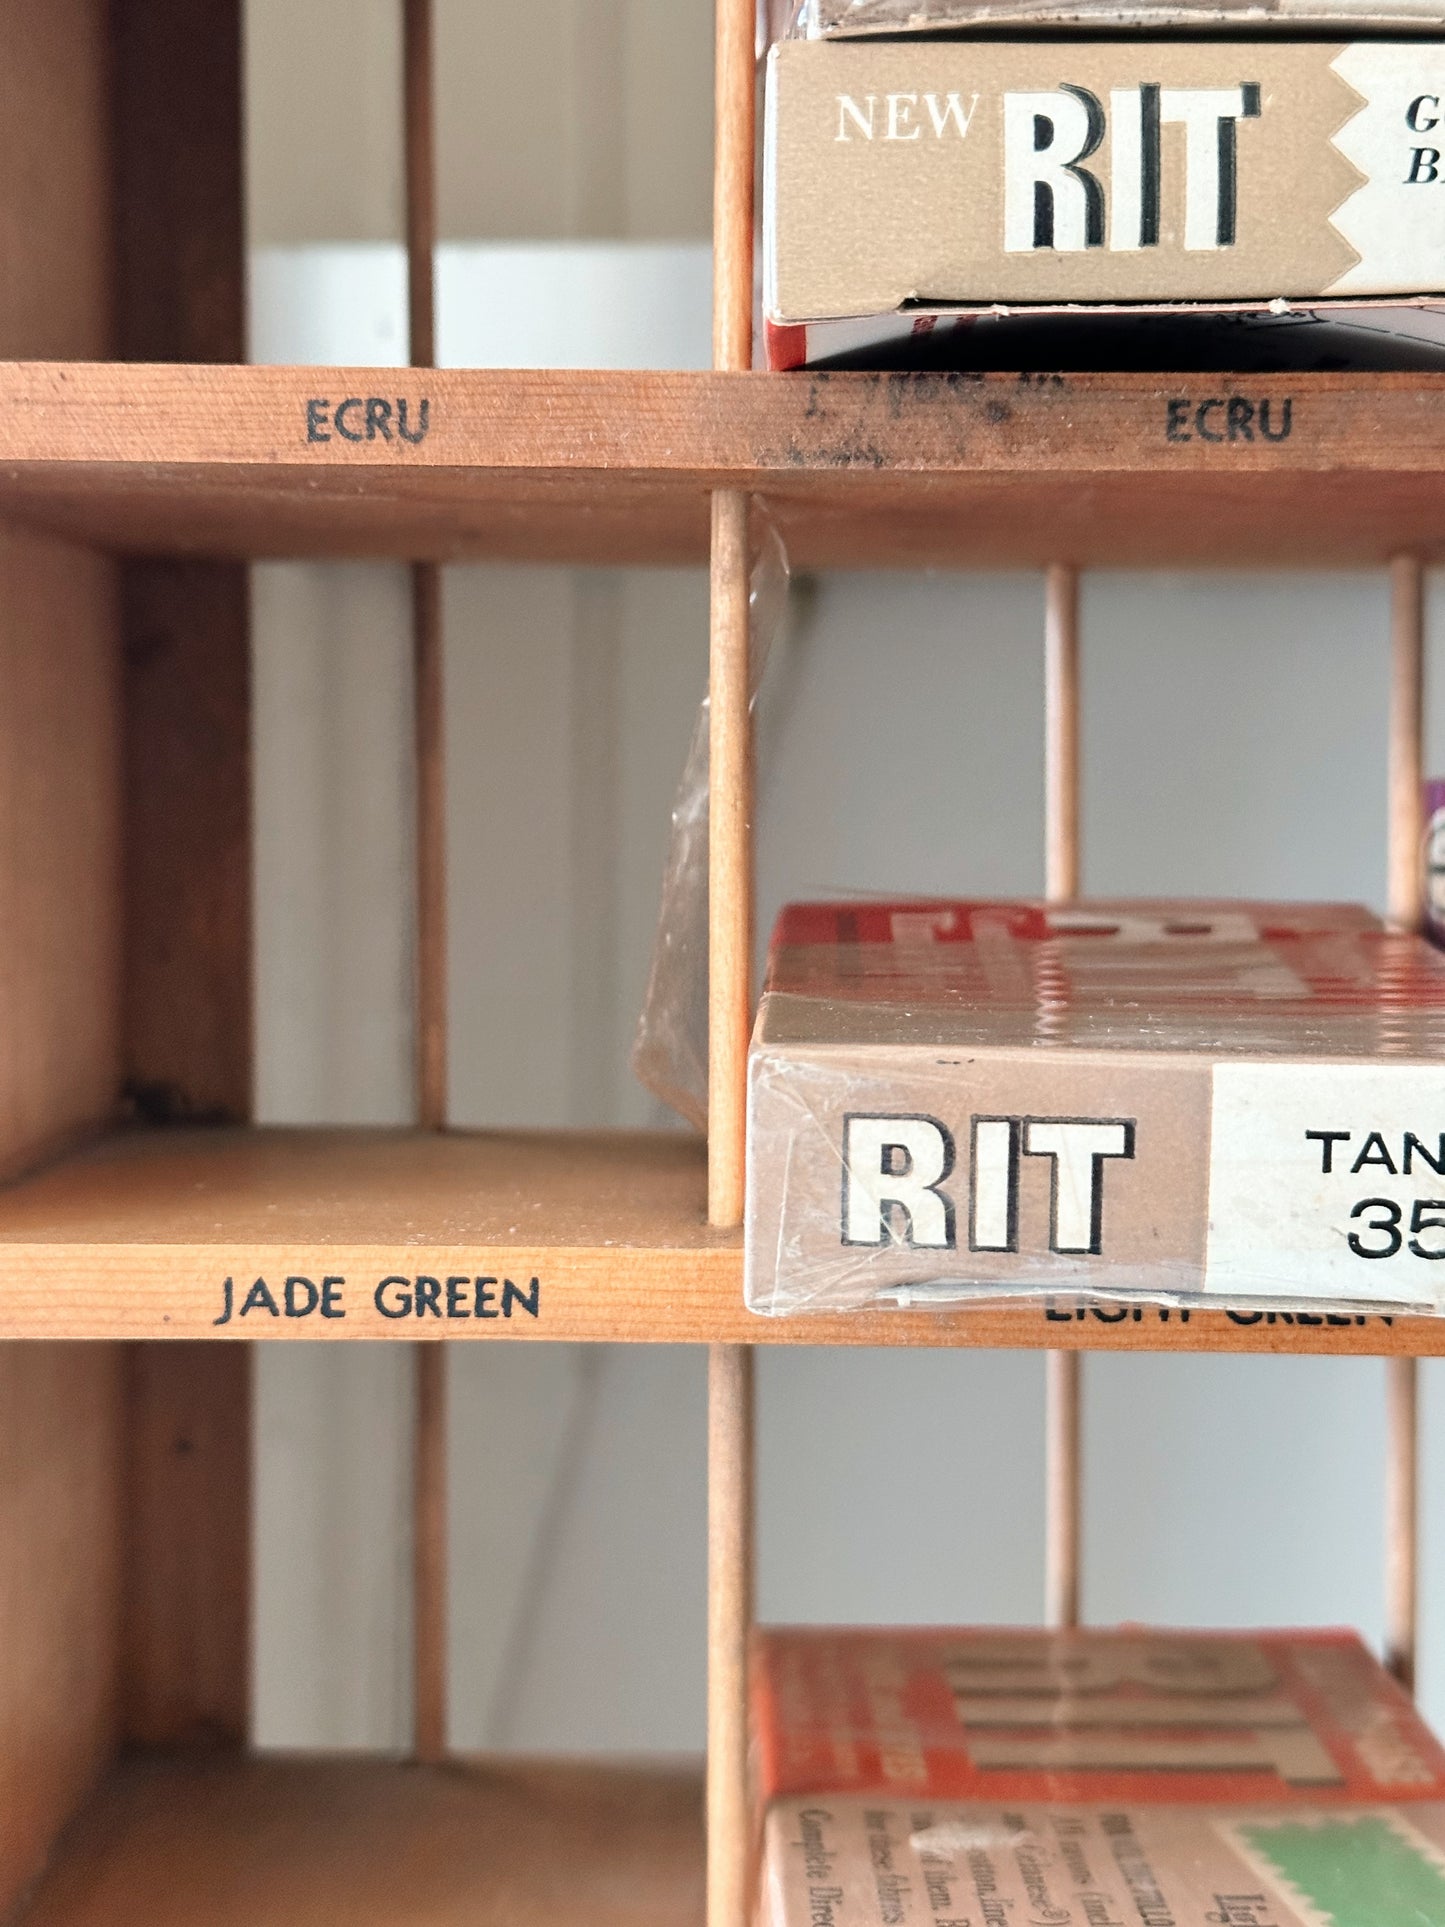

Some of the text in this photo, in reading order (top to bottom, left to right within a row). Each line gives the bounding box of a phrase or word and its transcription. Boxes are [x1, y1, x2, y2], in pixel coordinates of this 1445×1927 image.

[835, 93, 979, 142] NEW
[1405, 94, 1445, 133] G
[1003, 81, 1262, 253] RIT
[1402, 146, 1445, 184] B
[306, 397, 430, 444] ECRU
[1166, 396, 1293, 443] ECRU
[1304, 1129, 1445, 1175] TAN
[842, 1112, 1137, 1255] RIT
[213, 1276, 539, 1326] JADE GREEN
[1205, 1892, 1281, 1927] Lig
